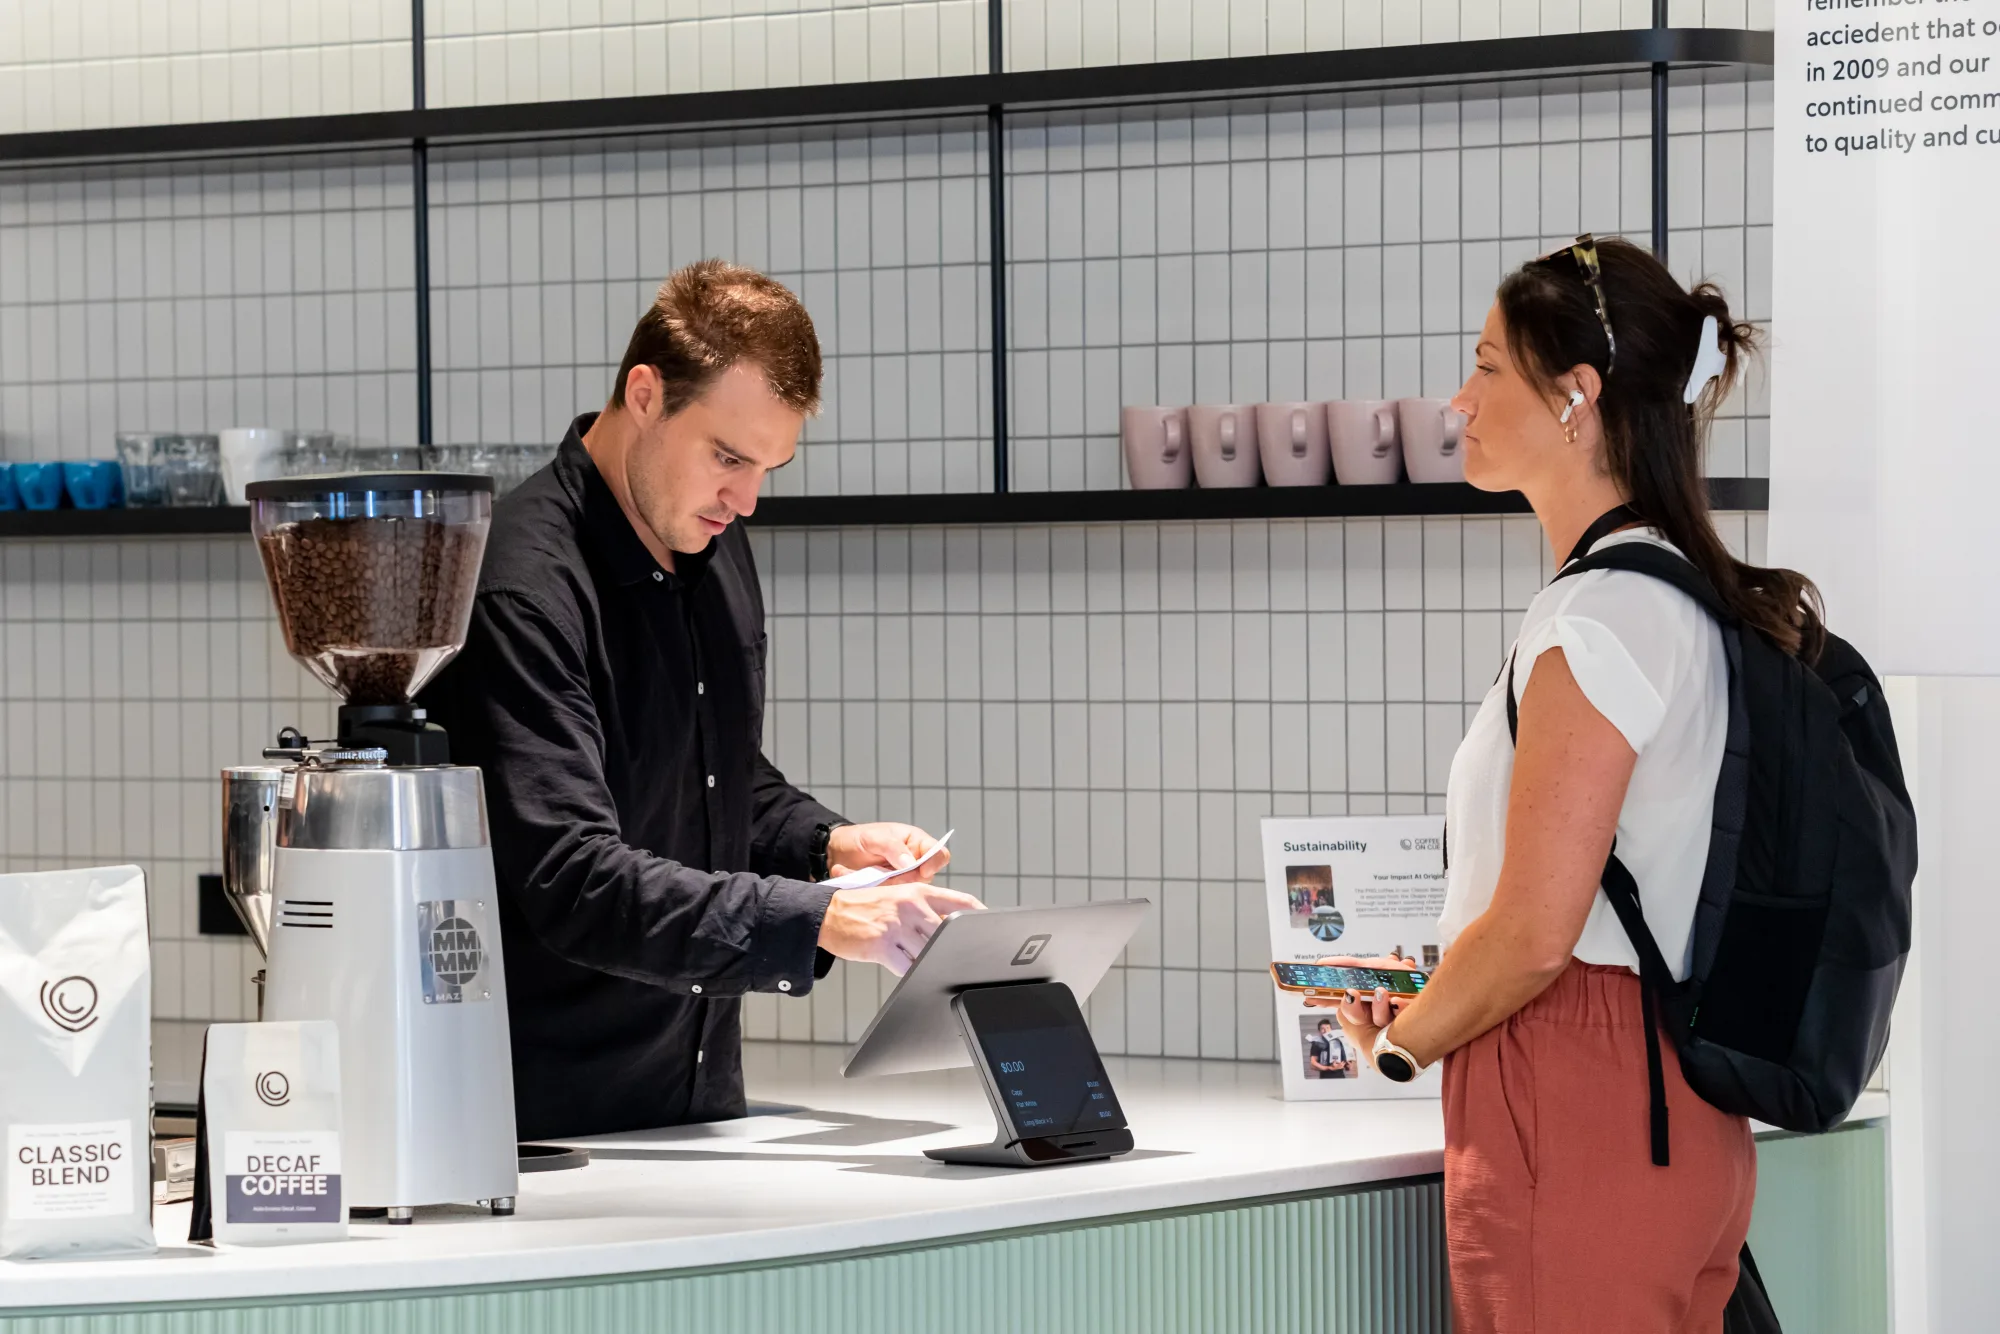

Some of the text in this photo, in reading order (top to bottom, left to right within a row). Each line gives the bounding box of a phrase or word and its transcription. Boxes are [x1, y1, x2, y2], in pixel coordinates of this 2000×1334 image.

[1806, 18, 2000, 46] acciedent that o
[1806, 54, 1990, 82] in 2009 and our
[1806, 91, 1922, 117] continued
[1806, 134, 1827, 152] to
[1834, 128, 1916, 156] quality
[1923, 125, 1967, 147] and
[1284, 840, 1367, 852] Sustainability
[1001, 1061, 1024, 1073] $0.00
[19, 1143, 122, 1164] CLASSIC
[247, 1155, 321, 1172] DECAF
[32, 1165, 110, 1186] BLEND
[241, 1175, 327, 1196] COFFEE
